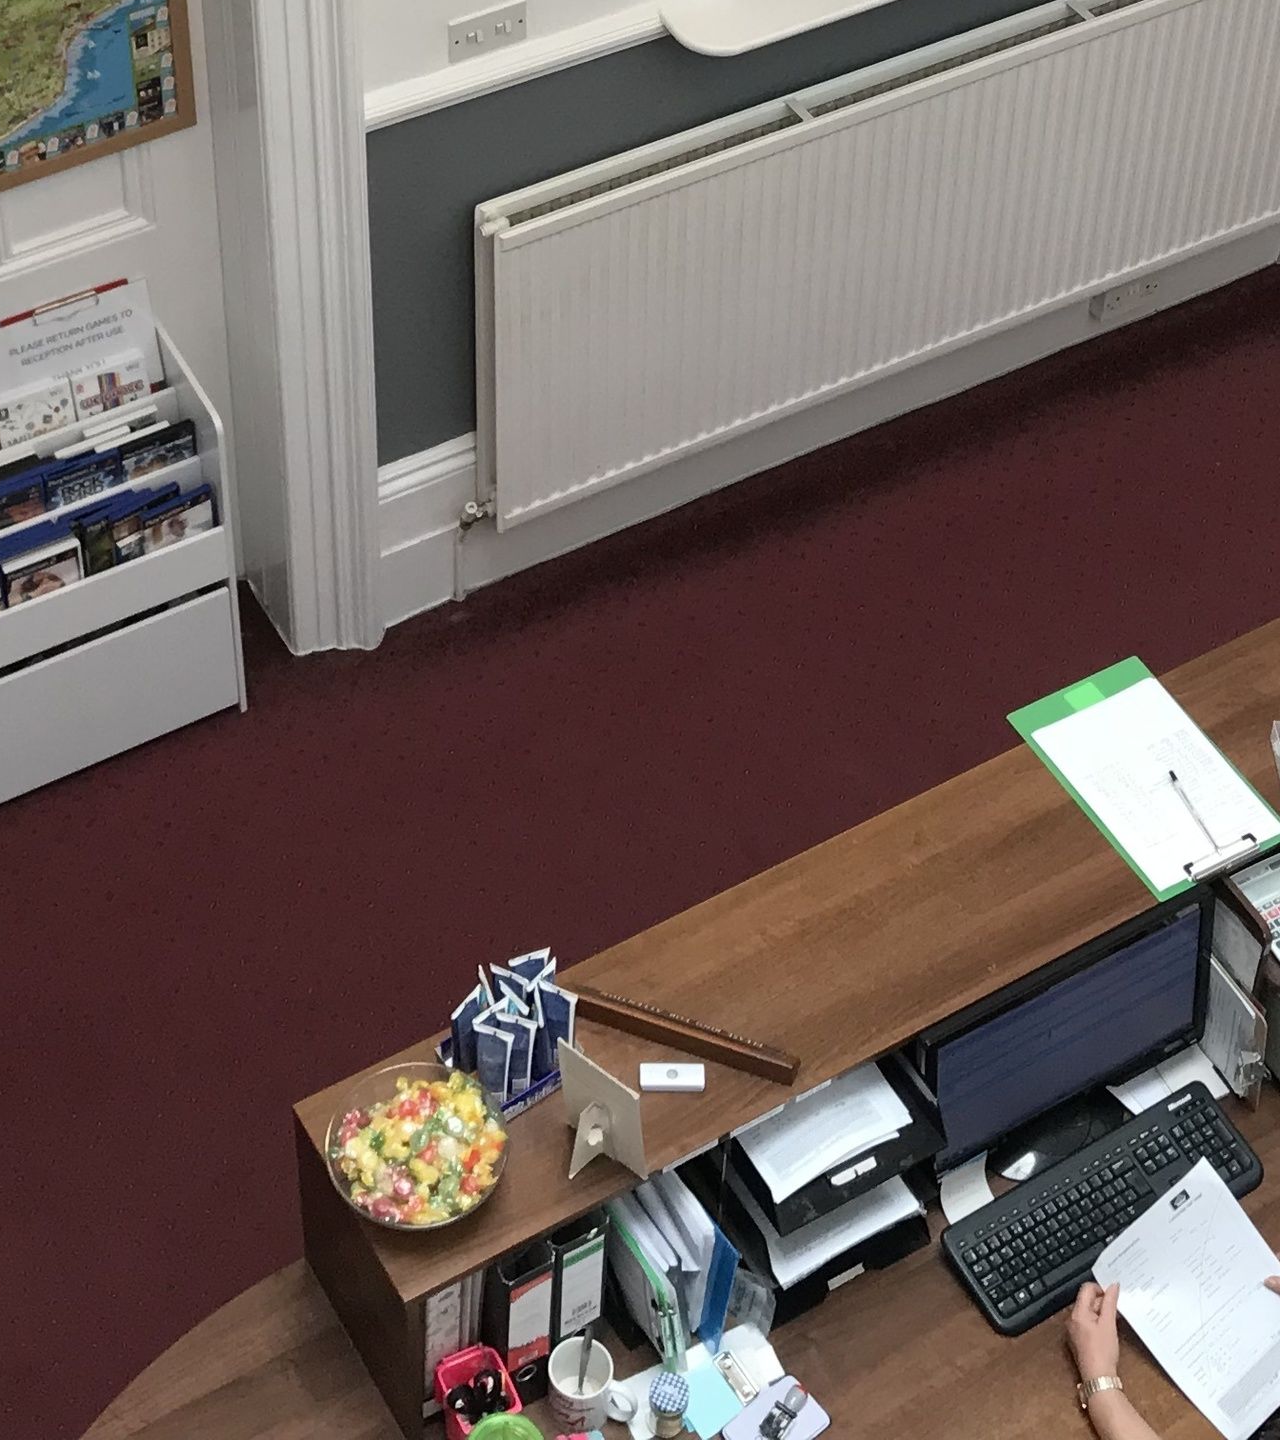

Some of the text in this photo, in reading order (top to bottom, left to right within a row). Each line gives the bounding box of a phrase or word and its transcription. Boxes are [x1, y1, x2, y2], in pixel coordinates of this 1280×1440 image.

[9, 309, 133, 356] PLEASE RETURN GAMES TO
[21, 325, 124, 367] RECEPTION AFTER USE
[62, 475, 104, 497] ROCK
